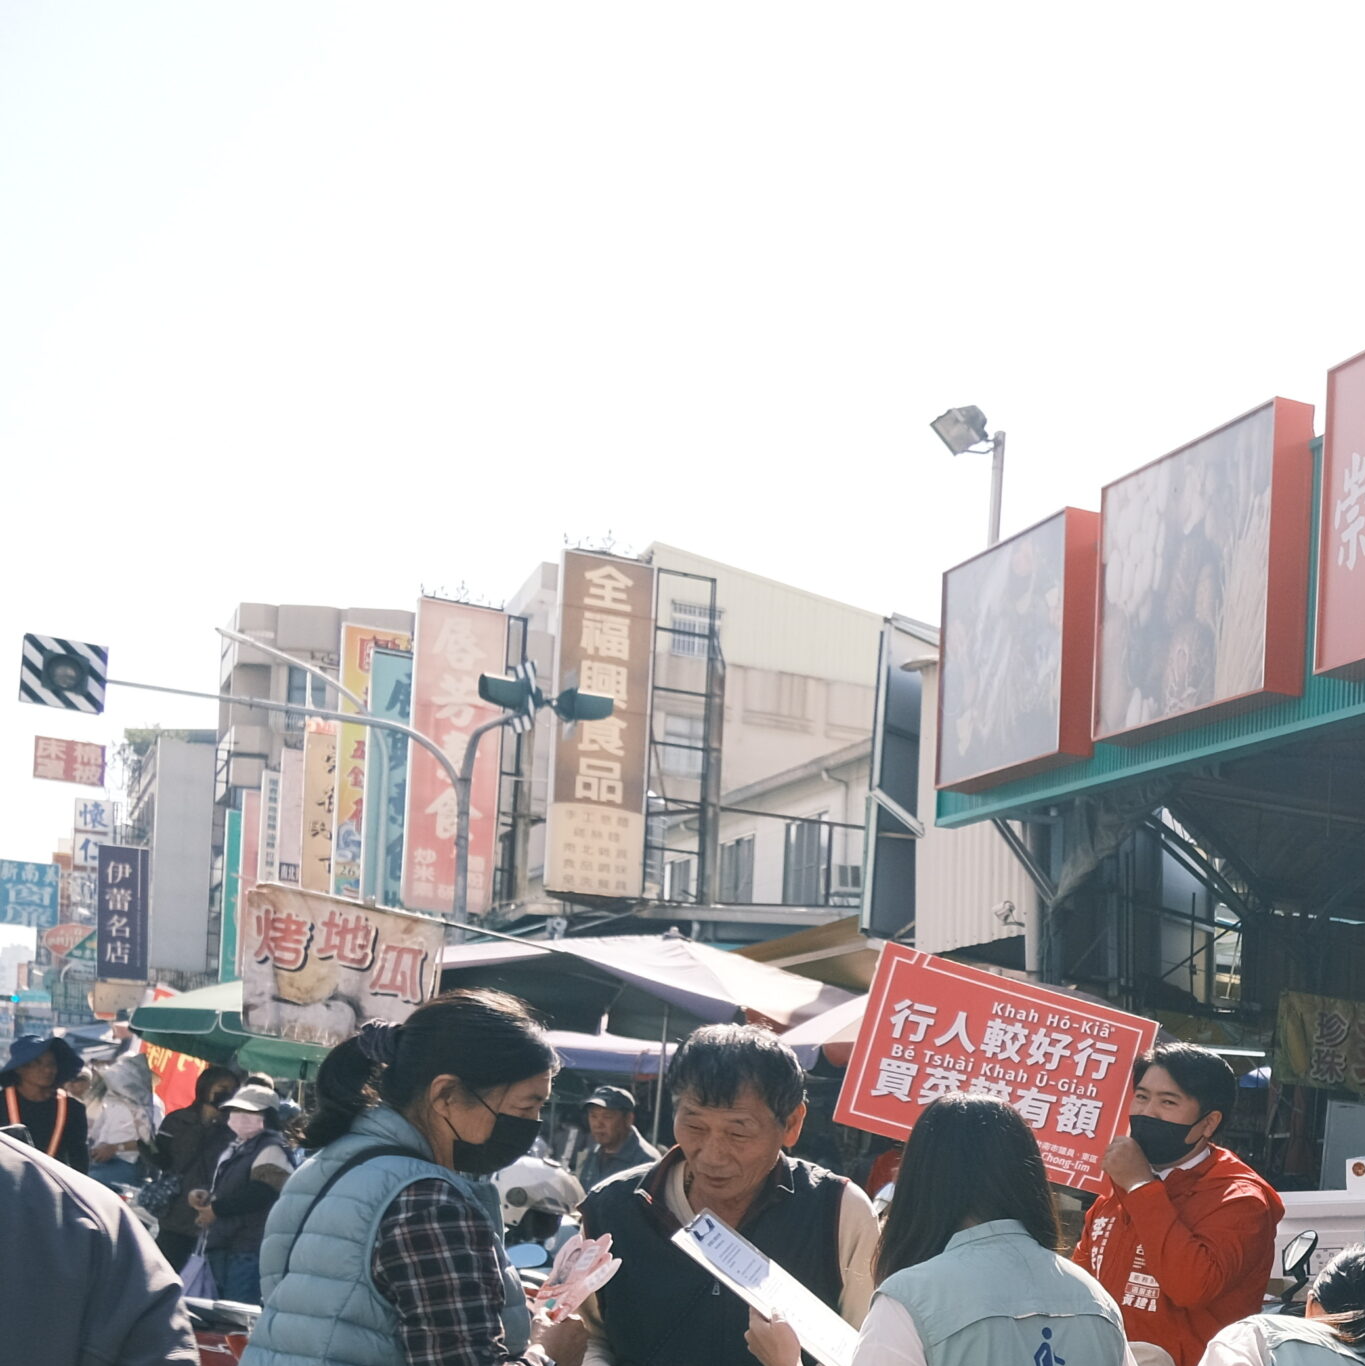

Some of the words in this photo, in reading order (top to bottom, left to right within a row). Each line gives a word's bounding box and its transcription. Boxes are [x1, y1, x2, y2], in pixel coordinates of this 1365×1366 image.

[105, 860, 133, 965] 伊蕾名店
[254, 908, 427, 1003] 烤地瓜
[890, 999, 1118, 1081] 行人較好行
[992, 1002, 1039, 1023] Khah
[1310, 1010, 1349, 1084] 珍珠
[891, 1043, 915, 1060] Bé
[923, 1050, 974, 1072] Tshài
[980, 1062, 1028, 1083] Khah
